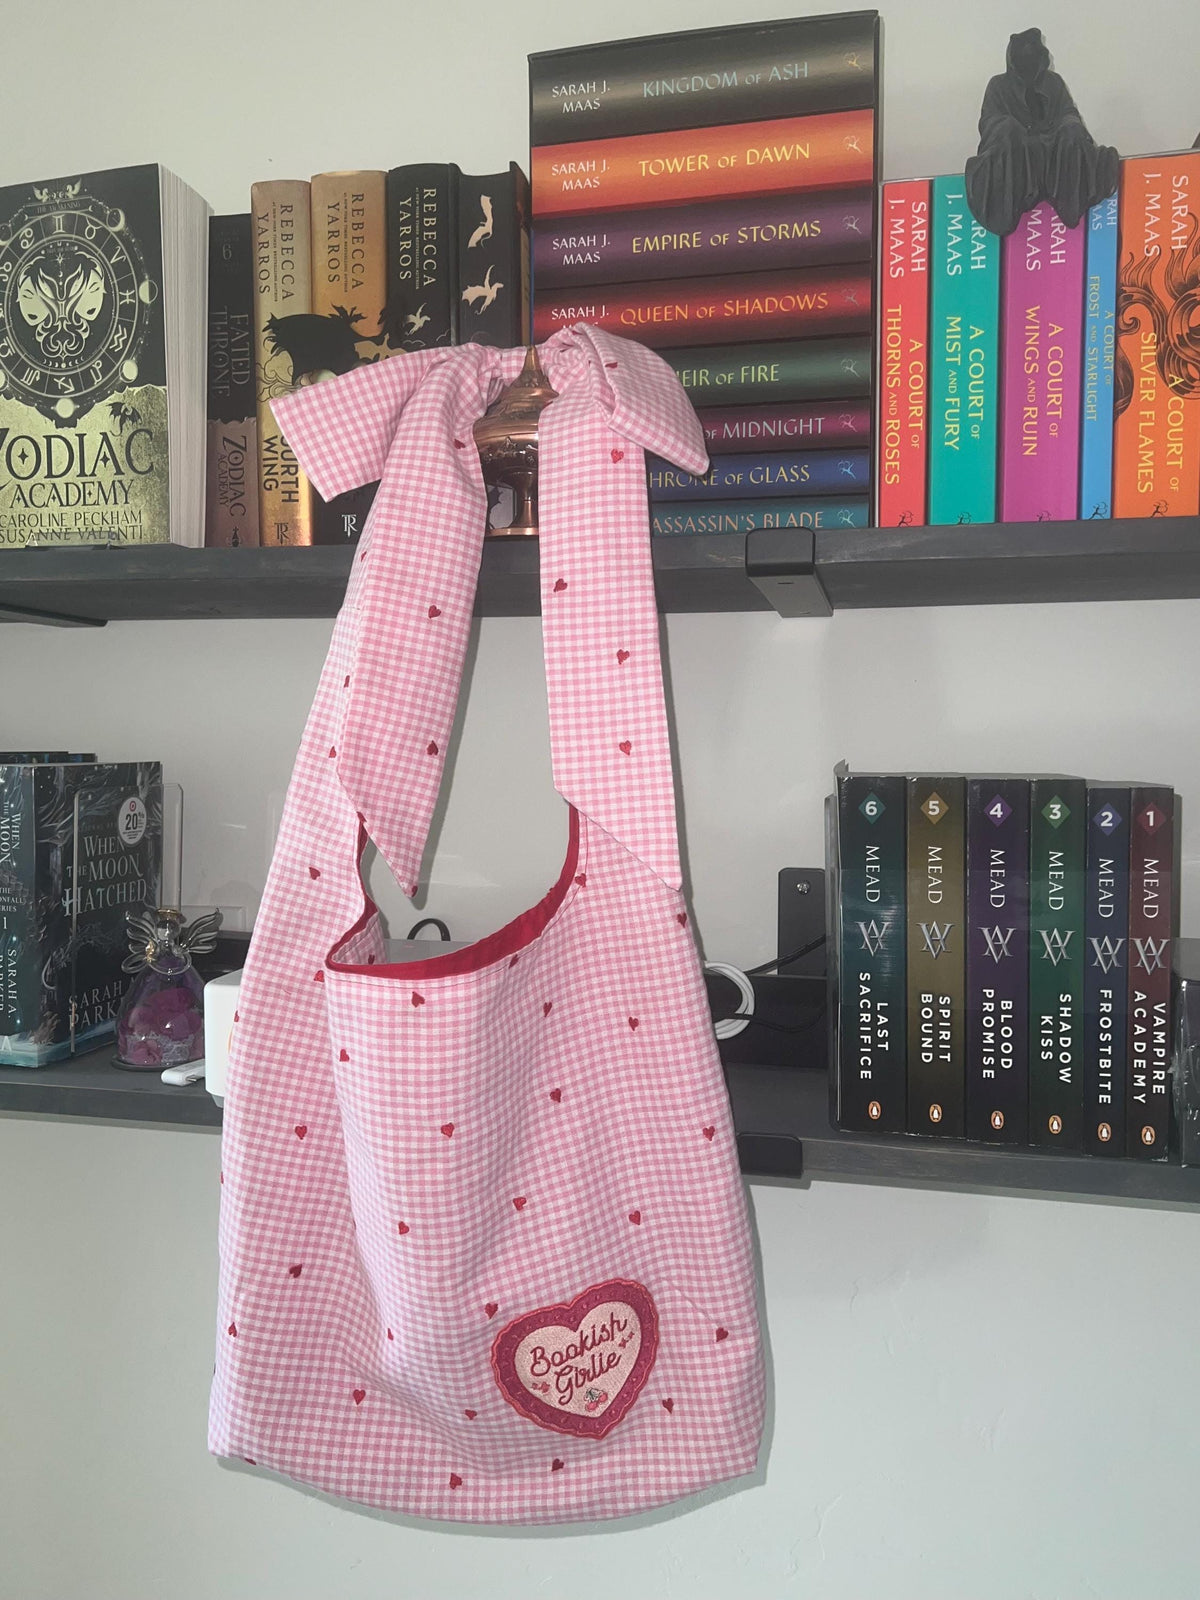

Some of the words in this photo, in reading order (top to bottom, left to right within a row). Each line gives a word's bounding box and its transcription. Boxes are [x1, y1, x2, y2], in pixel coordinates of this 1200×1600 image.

[551, 82, 596, 98] SARAH
[601, 79, 611, 94] J.
[642, 71, 739, 98] KINGDOM
[768, 62, 809, 83] ASH
[562, 99, 601, 114] MAAS
[551, 160, 596, 177] SARAH
[601, 158, 610, 173] J.
[562, 177, 601, 192] MAAS
[638, 154, 710, 178] TOWER
[745, 144, 811, 167] DAWN
[1142, 172, 1162, 184] J.
[887, 198, 906, 211] J.
[945, 193, 963, 205] J.
[1106, 198, 1118, 226] RAH
[1172, 175, 1188, 251] SARAH
[327, 202, 340, 283] YARROS
[351, 193, 365, 289] REBECCA
[399, 197, 412, 280] YARROS
[423, 188, 437, 286] REBECCA
[552, 235, 597, 251] SARAH
[601, 233, 610, 248] J.
[632, 231, 702, 254] EMPIRE
[737, 221, 822, 244] STORMS
[889, 218, 905, 278] MAAS
[911, 200, 927, 273] SARAH
[946, 213, 963, 276] MAAS
[970, 217, 986, 270] RAH
[1025, 209, 1042, 271] MAAS
[1144, 192, 1161, 258] MAAS
[222, 243, 232, 260] 6
[257, 212, 271, 294] YARROS
[280, 204, 295, 300] REBECCA
[562, 251, 601, 266] MAAS
[551, 306, 596, 320] SARAH
[600, 304, 610, 318] J.
[620, 303, 689, 326] QUEEN
[723, 292, 829, 316] SHADOWS
[1089, 275, 1100, 319] FROST
[1104, 310, 1114, 320] A
[209, 305, 230, 398] THRONE
[230, 314, 250, 385] FATED
[886, 304, 902, 387] THORNS
[909, 339, 924, 353] A
[945, 316, 962, 366] MIST
[969, 325, 985, 340] A
[1023, 305, 1041, 374] WINGS
[1048, 323, 1064, 338] A
[1103, 324, 1114, 372] COURT
[676, 368, 710, 387] EIR
[740, 364, 780, 384] FIRE
[968, 349, 985, 421] COURT
[1046, 346, 1064, 419] COURT
[1086, 347, 1099, 422] STARLIGHT
[1140, 332, 1158, 403] SILVER
[1168, 374, 1185, 388] A
[908, 361, 924, 431] COURT
[723, 417, 825, 439] MIDNIGHT
[944, 398, 961, 451] FURY
[1022, 407, 1038, 457] RUIN
[1167, 397, 1185, 469] COURT
[222, 435, 247, 517] ZODIAC
[262, 435, 278, 492] WING
[650, 469, 719, 488] HRONE
[750, 464, 810, 484] GLASS
[884, 419, 901, 485] ROSES
[1137, 409, 1155, 494] FLAMES
[9, 479, 134, 509] ACADEMY
[217, 453, 230, 509] ACADEMY
[0, 512, 68, 529] CAROLINE
[74, 510, 142, 527] PECKHAM
[0, 527, 72, 543] SUSANNE
[77, 525, 143, 541] VALENTI
[653, 512, 756, 533] ASSASSIN'S
[763, 511, 824, 529] BLADE
[11, 813, 21, 849] WHEN
[865, 801, 878, 816] 6
[928, 801, 940, 815] 5
[989, 803, 1003, 818] 4
[1049, 804, 1062, 819] 3
[1101, 812, 1113, 827] 2
[1146, 811, 1155, 827] 1
[0, 817, 11, 863] MOON
[88, 853, 143, 882] MOON
[866, 845, 880, 903] MEAD
[927, 845, 943, 904] MEAD
[990, 849, 1005, 908] MEAD
[1048, 850, 1064, 911] MEAD
[1098, 858, 1114, 918] MEAD
[1143, 858, 1159, 919] MEAD
[62, 878, 153, 917] HATCHED
[3, 916, 8, 930] 1
[7, 949, 17, 1000] SARAH
[7, 1004, 17, 1018] A.
[69, 1000, 118, 1031] PARK
[859, 972, 872, 1080] SACRIFICE
[877, 1002, 889, 1051] LAST
[921, 994, 933, 1063] BOUND
[939, 996, 951, 1062] SPIRIT
[982, 988, 995, 1079] PROMISE
[1001, 1001, 1013, 1070] BLOOD
[1041, 1016, 1053, 1060] KISS
[1058, 993, 1072, 1084] SHADOW
[1098, 989, 1112, 1104] FROSTBITE
[1133, 990, 1147, 1104] ACADEMY
[1152, 1003, 1166, 1095] VAMPIRE
[530, 1312, 628, 1377] Bookish
[554, 1351, 622, 1406] Girlie
